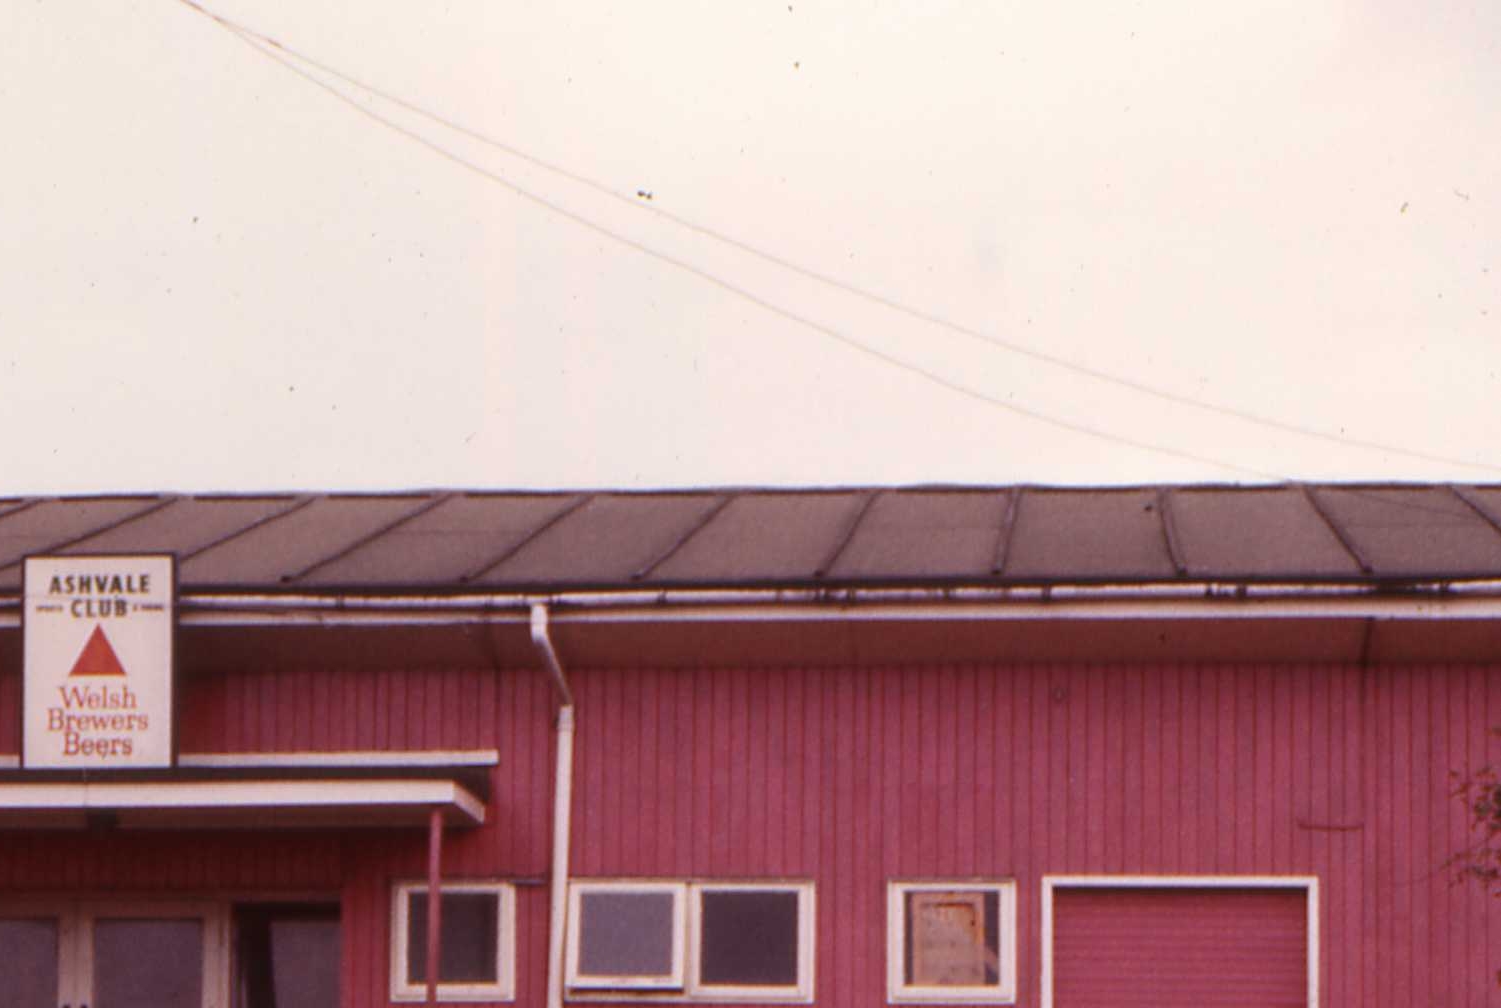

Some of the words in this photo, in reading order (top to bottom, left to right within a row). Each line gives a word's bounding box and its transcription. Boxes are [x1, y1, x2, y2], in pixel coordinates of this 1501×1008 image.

[50, 574, 151, 593] ASHVALE
[70, 598, 128, 618] CLUB
[58, 684, 137, 709] Welsh
[47, 708, 149, 732] Brewers
[62, 732, 133, 756] Beers
